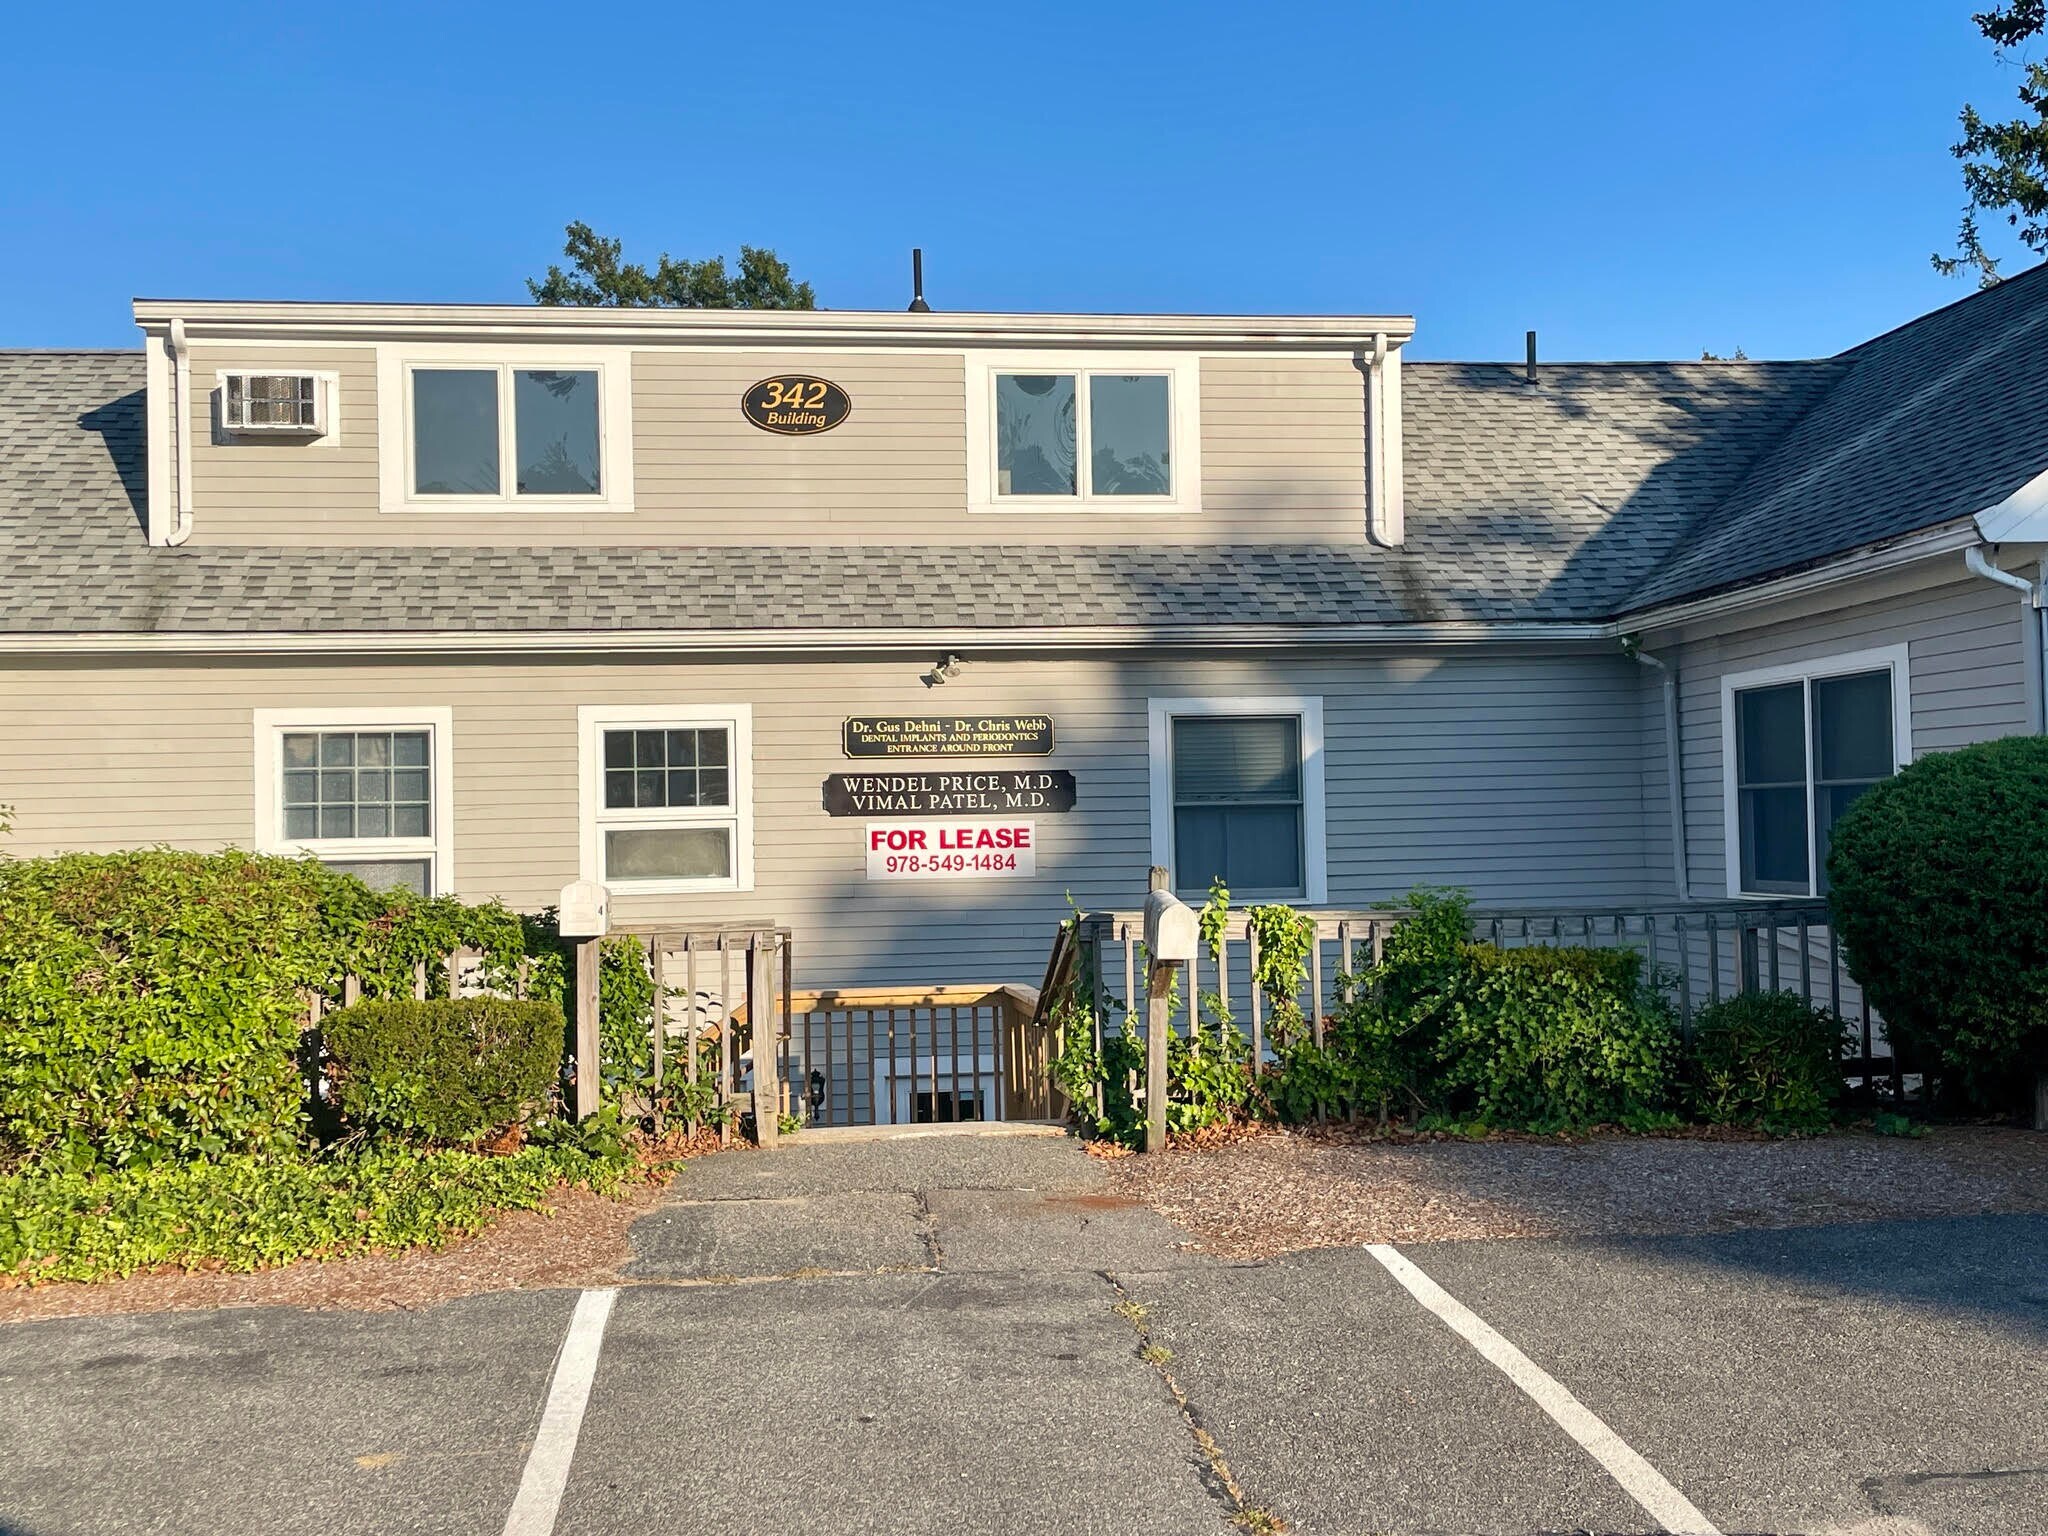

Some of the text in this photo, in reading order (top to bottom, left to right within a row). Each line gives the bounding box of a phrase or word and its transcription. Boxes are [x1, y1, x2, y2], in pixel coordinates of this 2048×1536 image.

[761, 382, 828, 409] 342
[767, 412, 826, 427] Building
[852, 721, 872, 733] Dr.
[876, 722, 900, 733] Gus
[904, 721, 942, 732] Dehni
[955, 720, 974, 732] Dr.
[981, 720, 1010, 731] Chris
[1014, 719, 1047, 731] Webb
[861, 733, 1039, 743] DENTAL IMPLANTS AND PERIODONTICS
[887, 743, 1013, 753] ENTRANCE AROUND FRONT
[843, 774, 1059, 794] WENDEL PRICE, M.D.
[852, 792, 1050, 811] VIMAL PATEL, M.D.
[871, 828, 1031, 850] FOR LEASE
[886, 853, 1016, 873] 978-549-1484
